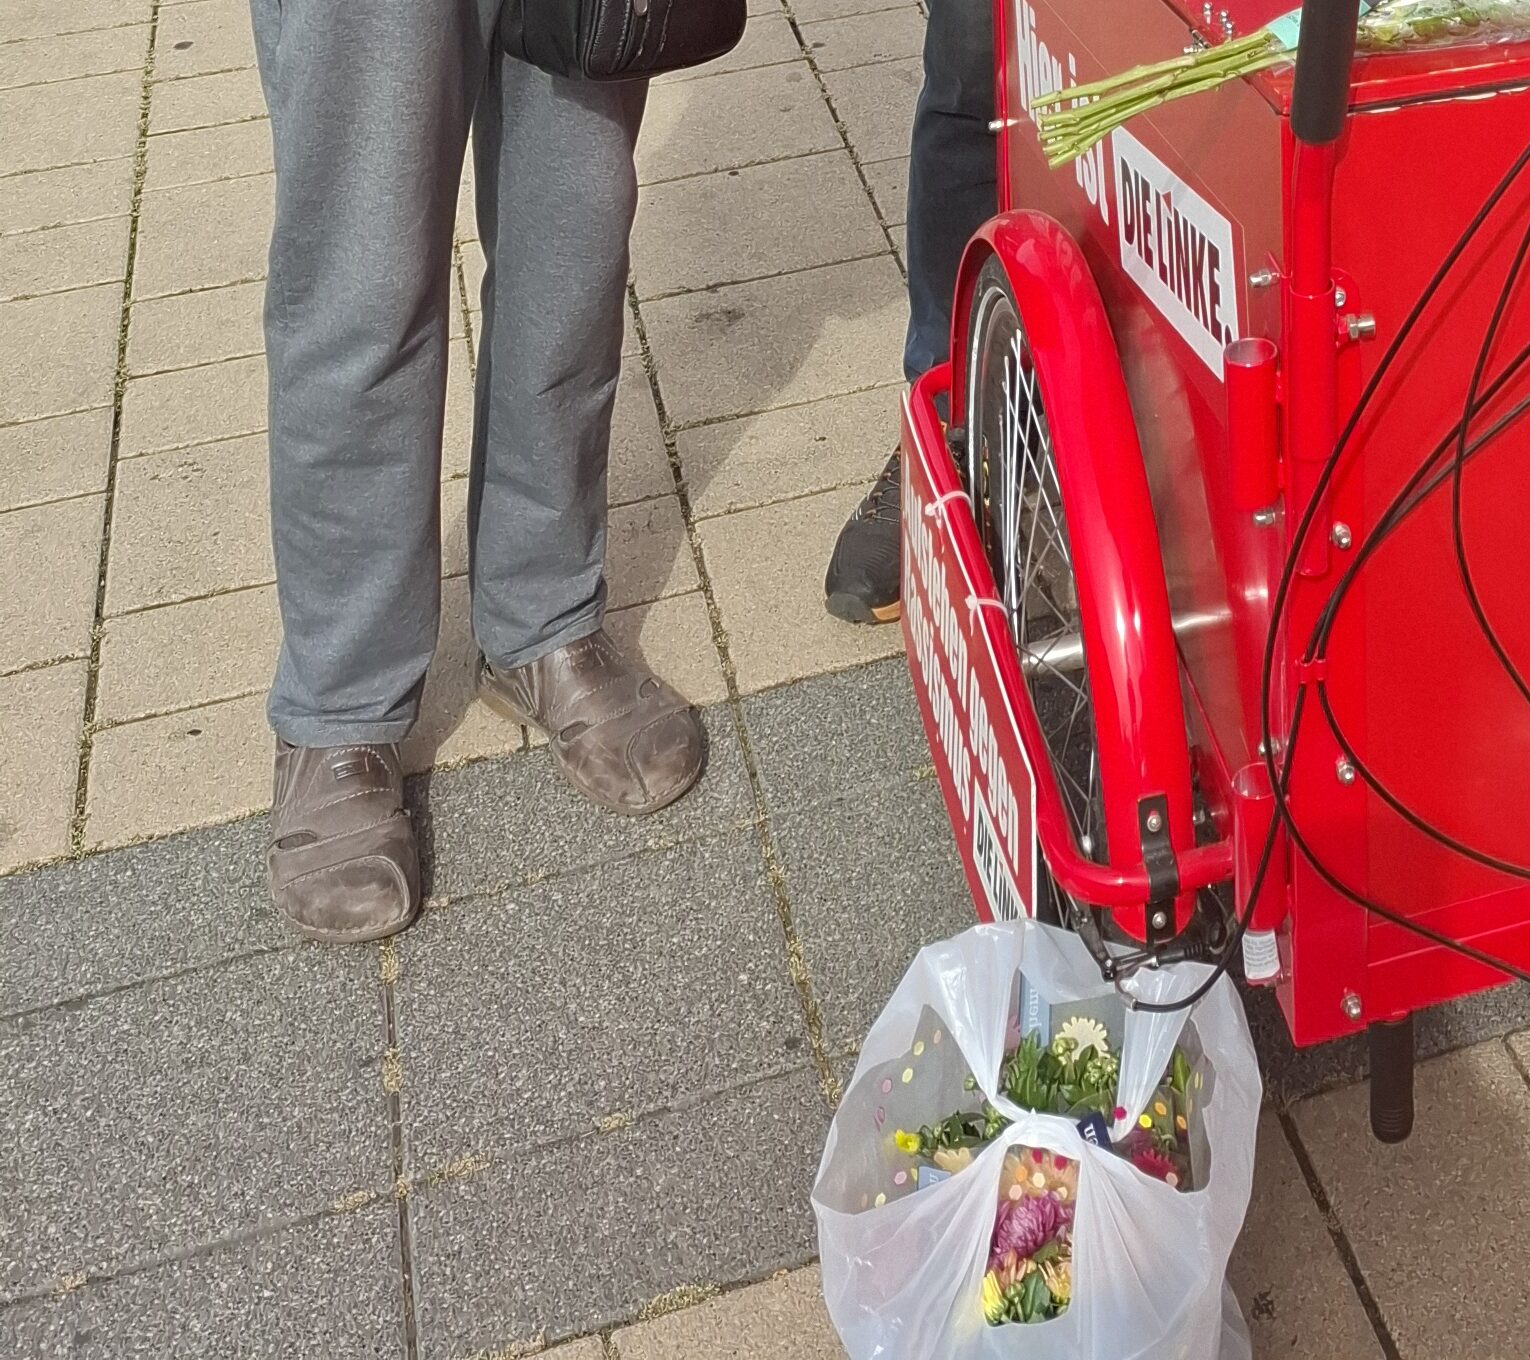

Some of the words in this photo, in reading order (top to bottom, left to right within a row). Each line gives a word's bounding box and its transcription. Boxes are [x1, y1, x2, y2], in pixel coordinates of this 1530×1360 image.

[1121, 156, 1154, 270] DIE
[1155, 188, 1233, 347] LINKE.
[903, 532, 971, 823] Rassismus
[904, 452, 968, 712] Aufstehen
[969, 666, 1019, 877] gegen
[977, 806, 993, 887] DIE
